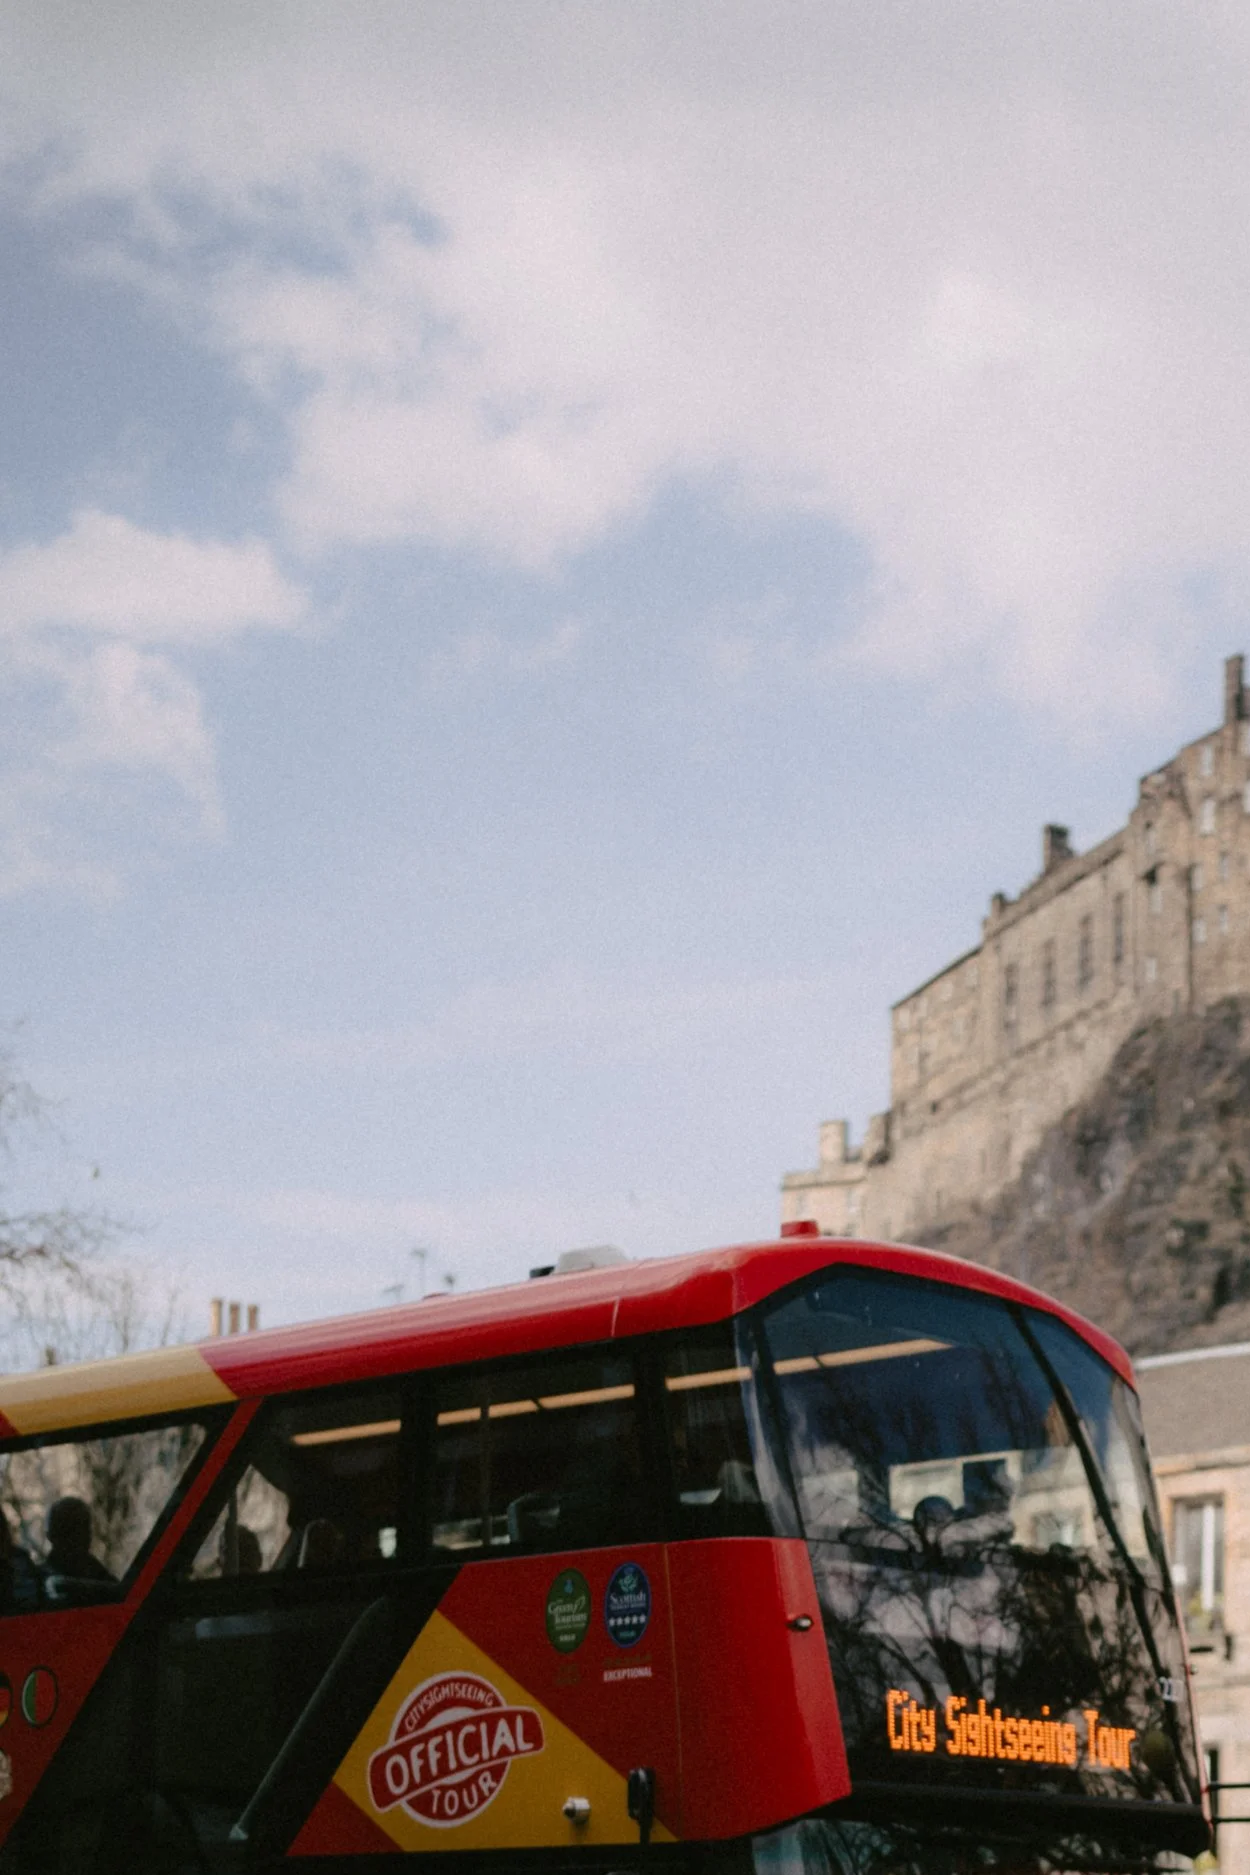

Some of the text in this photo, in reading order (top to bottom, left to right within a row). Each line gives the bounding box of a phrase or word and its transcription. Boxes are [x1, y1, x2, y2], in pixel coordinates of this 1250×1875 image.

[602, 1665, 653, 1682] EXCEPTIONAL
[384, 1713, 535, 1796] OFFICIAL
[886, 1688, 1137, 1770] City Sightseeing Tour
[431, 1769, 498, 1816] TOUR
